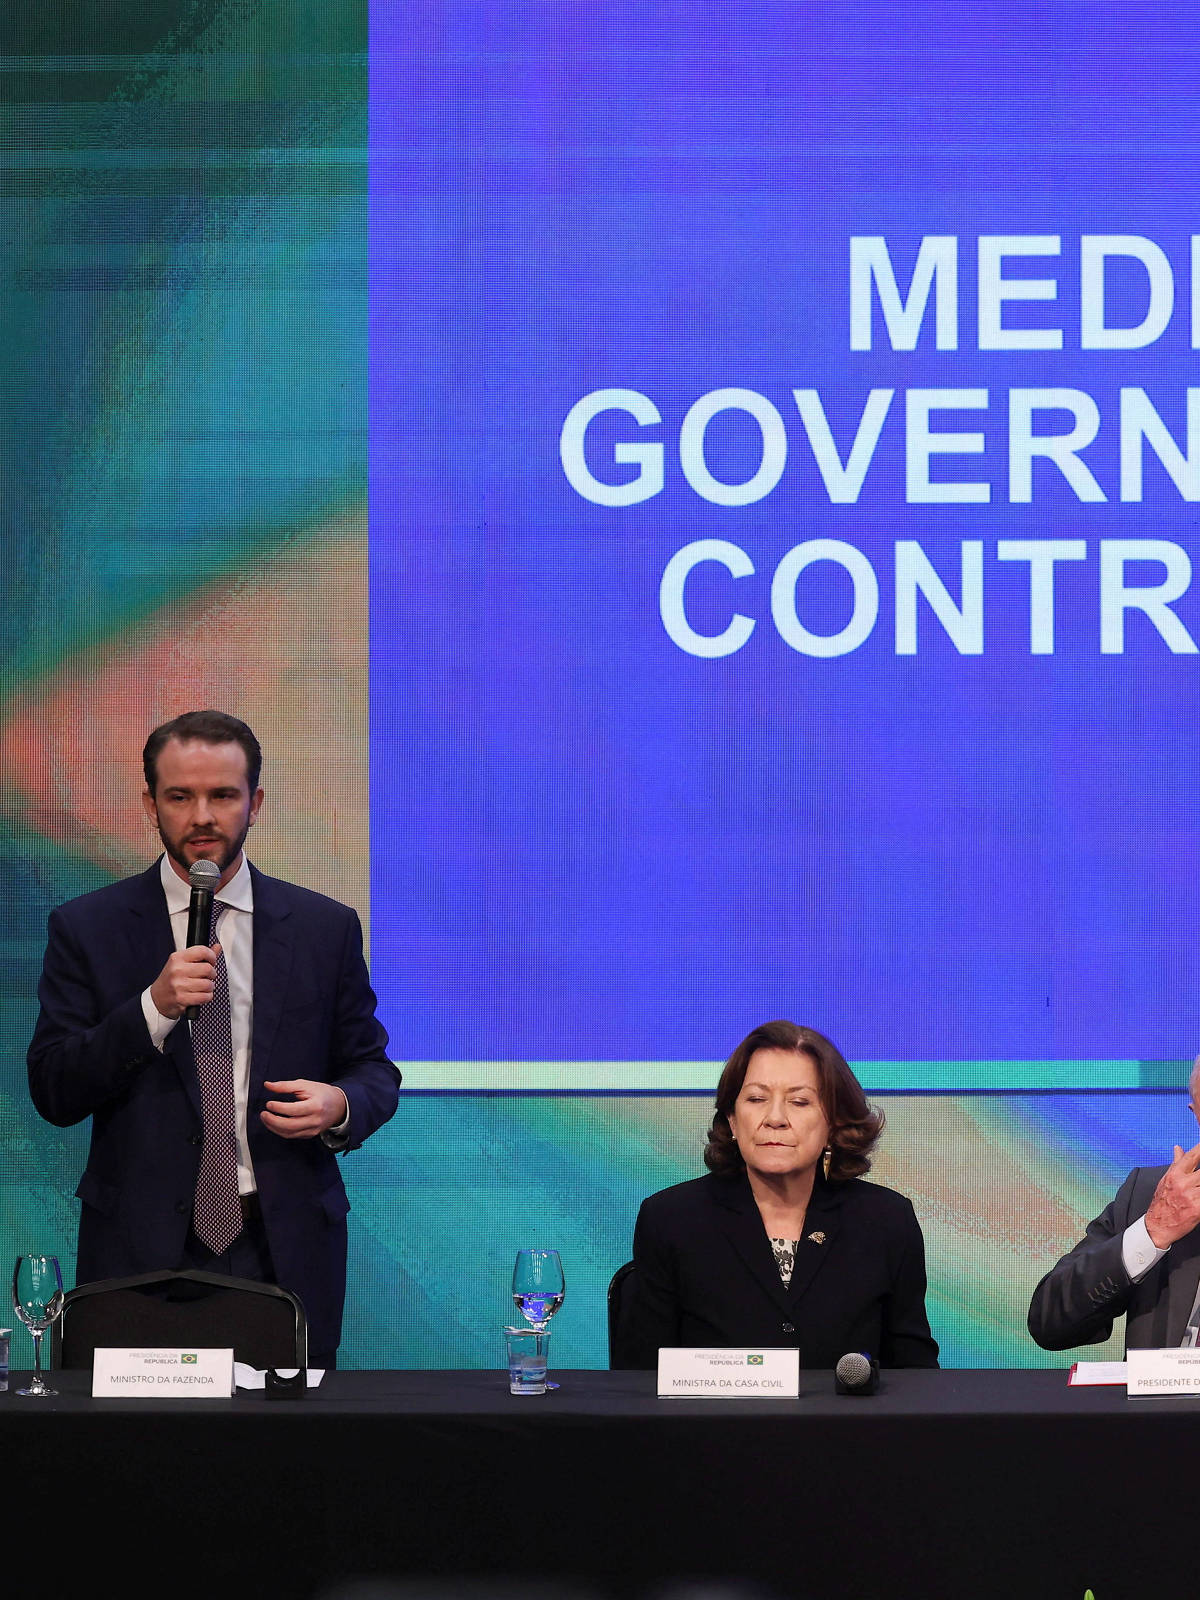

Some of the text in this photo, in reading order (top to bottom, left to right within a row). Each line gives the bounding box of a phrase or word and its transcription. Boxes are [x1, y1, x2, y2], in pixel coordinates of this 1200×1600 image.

[110, 1375, 214, 1384] MINISTRO DA FAZENDA
[672, 1379, 784, 1388] MINISTRA DA CASA CIVIL
[1137, 1378, 1191, 1387] PRESIDENTE
